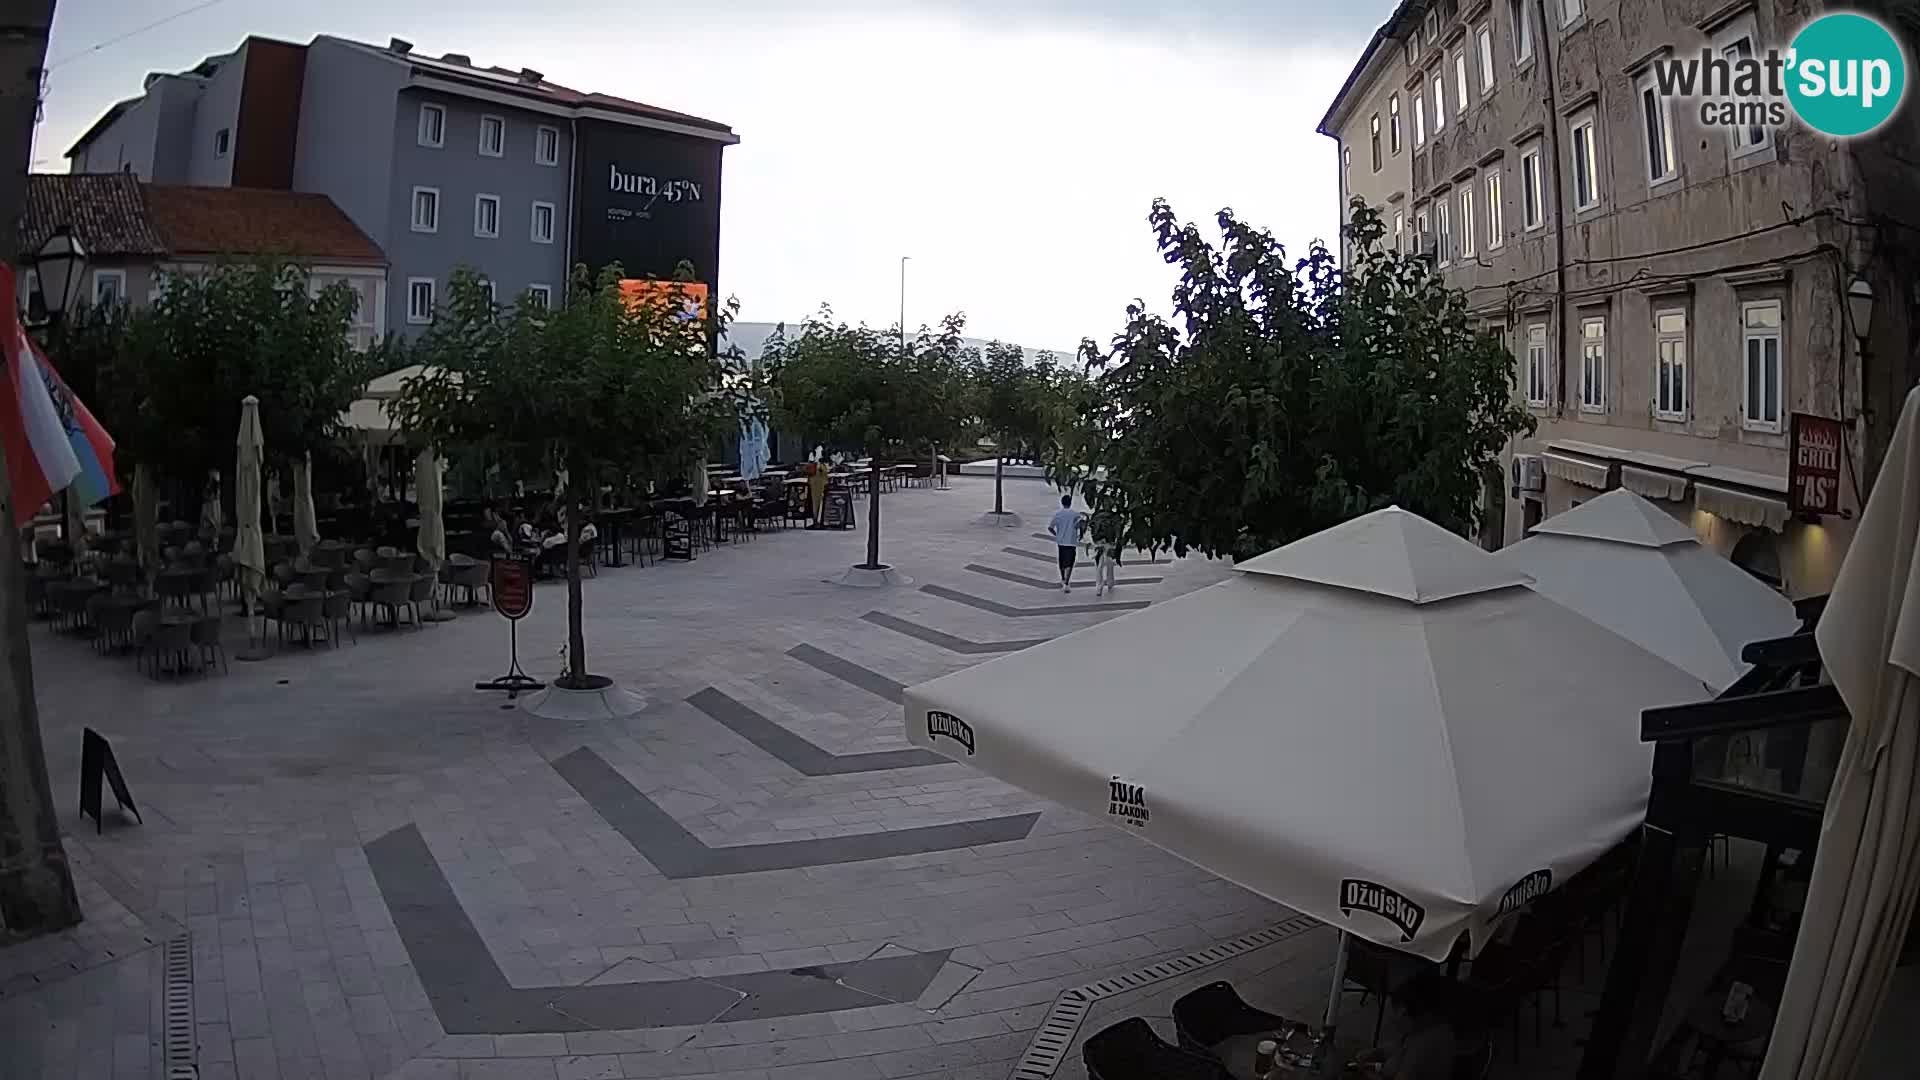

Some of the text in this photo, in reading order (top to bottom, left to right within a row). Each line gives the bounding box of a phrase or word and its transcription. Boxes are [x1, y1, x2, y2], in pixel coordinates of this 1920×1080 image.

[610, 164, 656, 196] bura
[1798, 447, 1836, 470] GRILL
[1108, 802, 1117, 815] JE
[1347, 881, 1418, 929] Ožujsko
